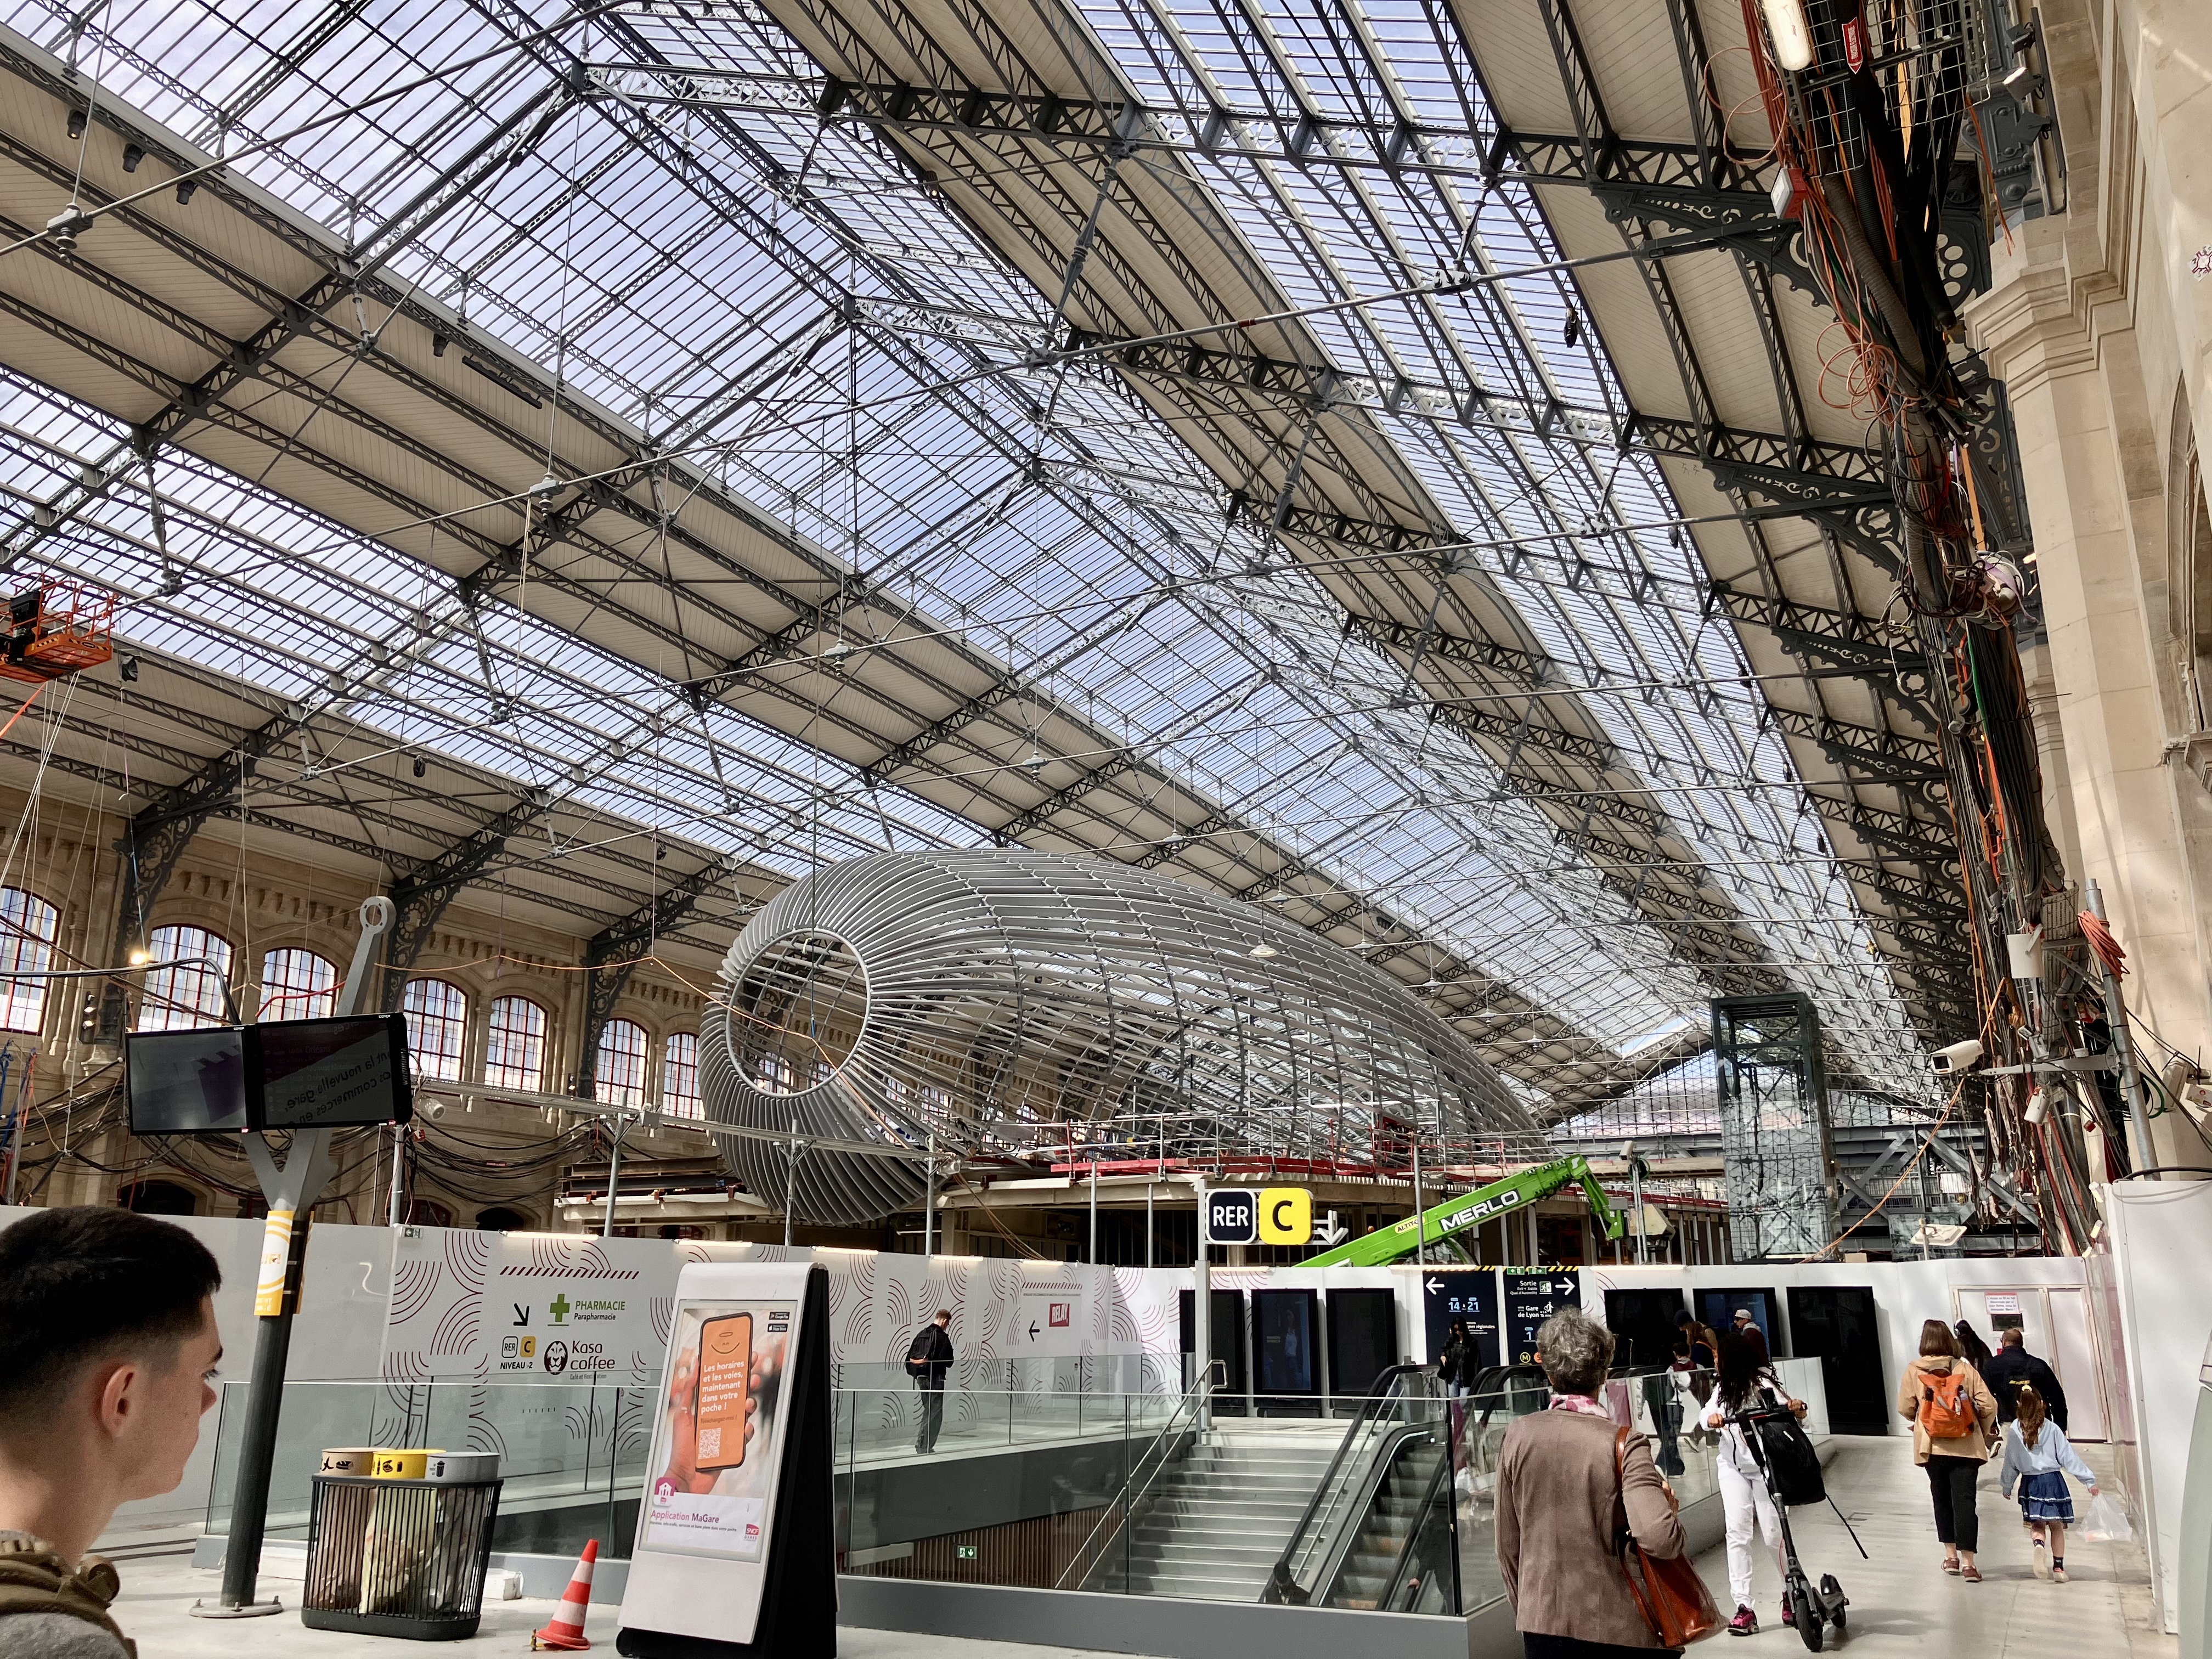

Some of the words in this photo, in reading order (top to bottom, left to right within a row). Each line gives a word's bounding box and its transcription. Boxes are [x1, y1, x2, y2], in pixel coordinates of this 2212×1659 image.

[1212, 1206, 1249, 1227] RER
[1272, 1200, 1294, 1232] C
[1441, 1190, 1519, 1232] MERLO
[575, 1300, 626, 1311] PHARMACIE
[1448, 1301, 1460, 1310] 14
[1467, 1301, 1479, 1310] 21
[574, 1312, 616, 1322] Parapharmacie
[1052, 1304, 1068, 1323] RELAY
[1526, 1331, 1532, 1340] 1
[504, 1343, 516, 1351] RER
[524, 1340, 532, 1353] C
[572, 1340, 603, 1354] Kasa
[500, 1362, 526, 1370] NIVEAU
[527, 1361, 533, 1369] -2
[570, 1356, 616, 1370] coffee
[704, 1364, 715, 1373] Les
[716, 1361, 745, 1371] horaires
[712, 1373, 722, 1381] les
[723, 1370, 743, 1380] voies,
[702, 1380, 741, 1393] maintenant
[702, 1394, 718, 1403] dans
[719, 1392, 738, 1401] votre
[701, 1404, 723, 1415] poche
[651, 1510, 690, 1521] Application
[691, 1513, 719, 1523] MaGare
